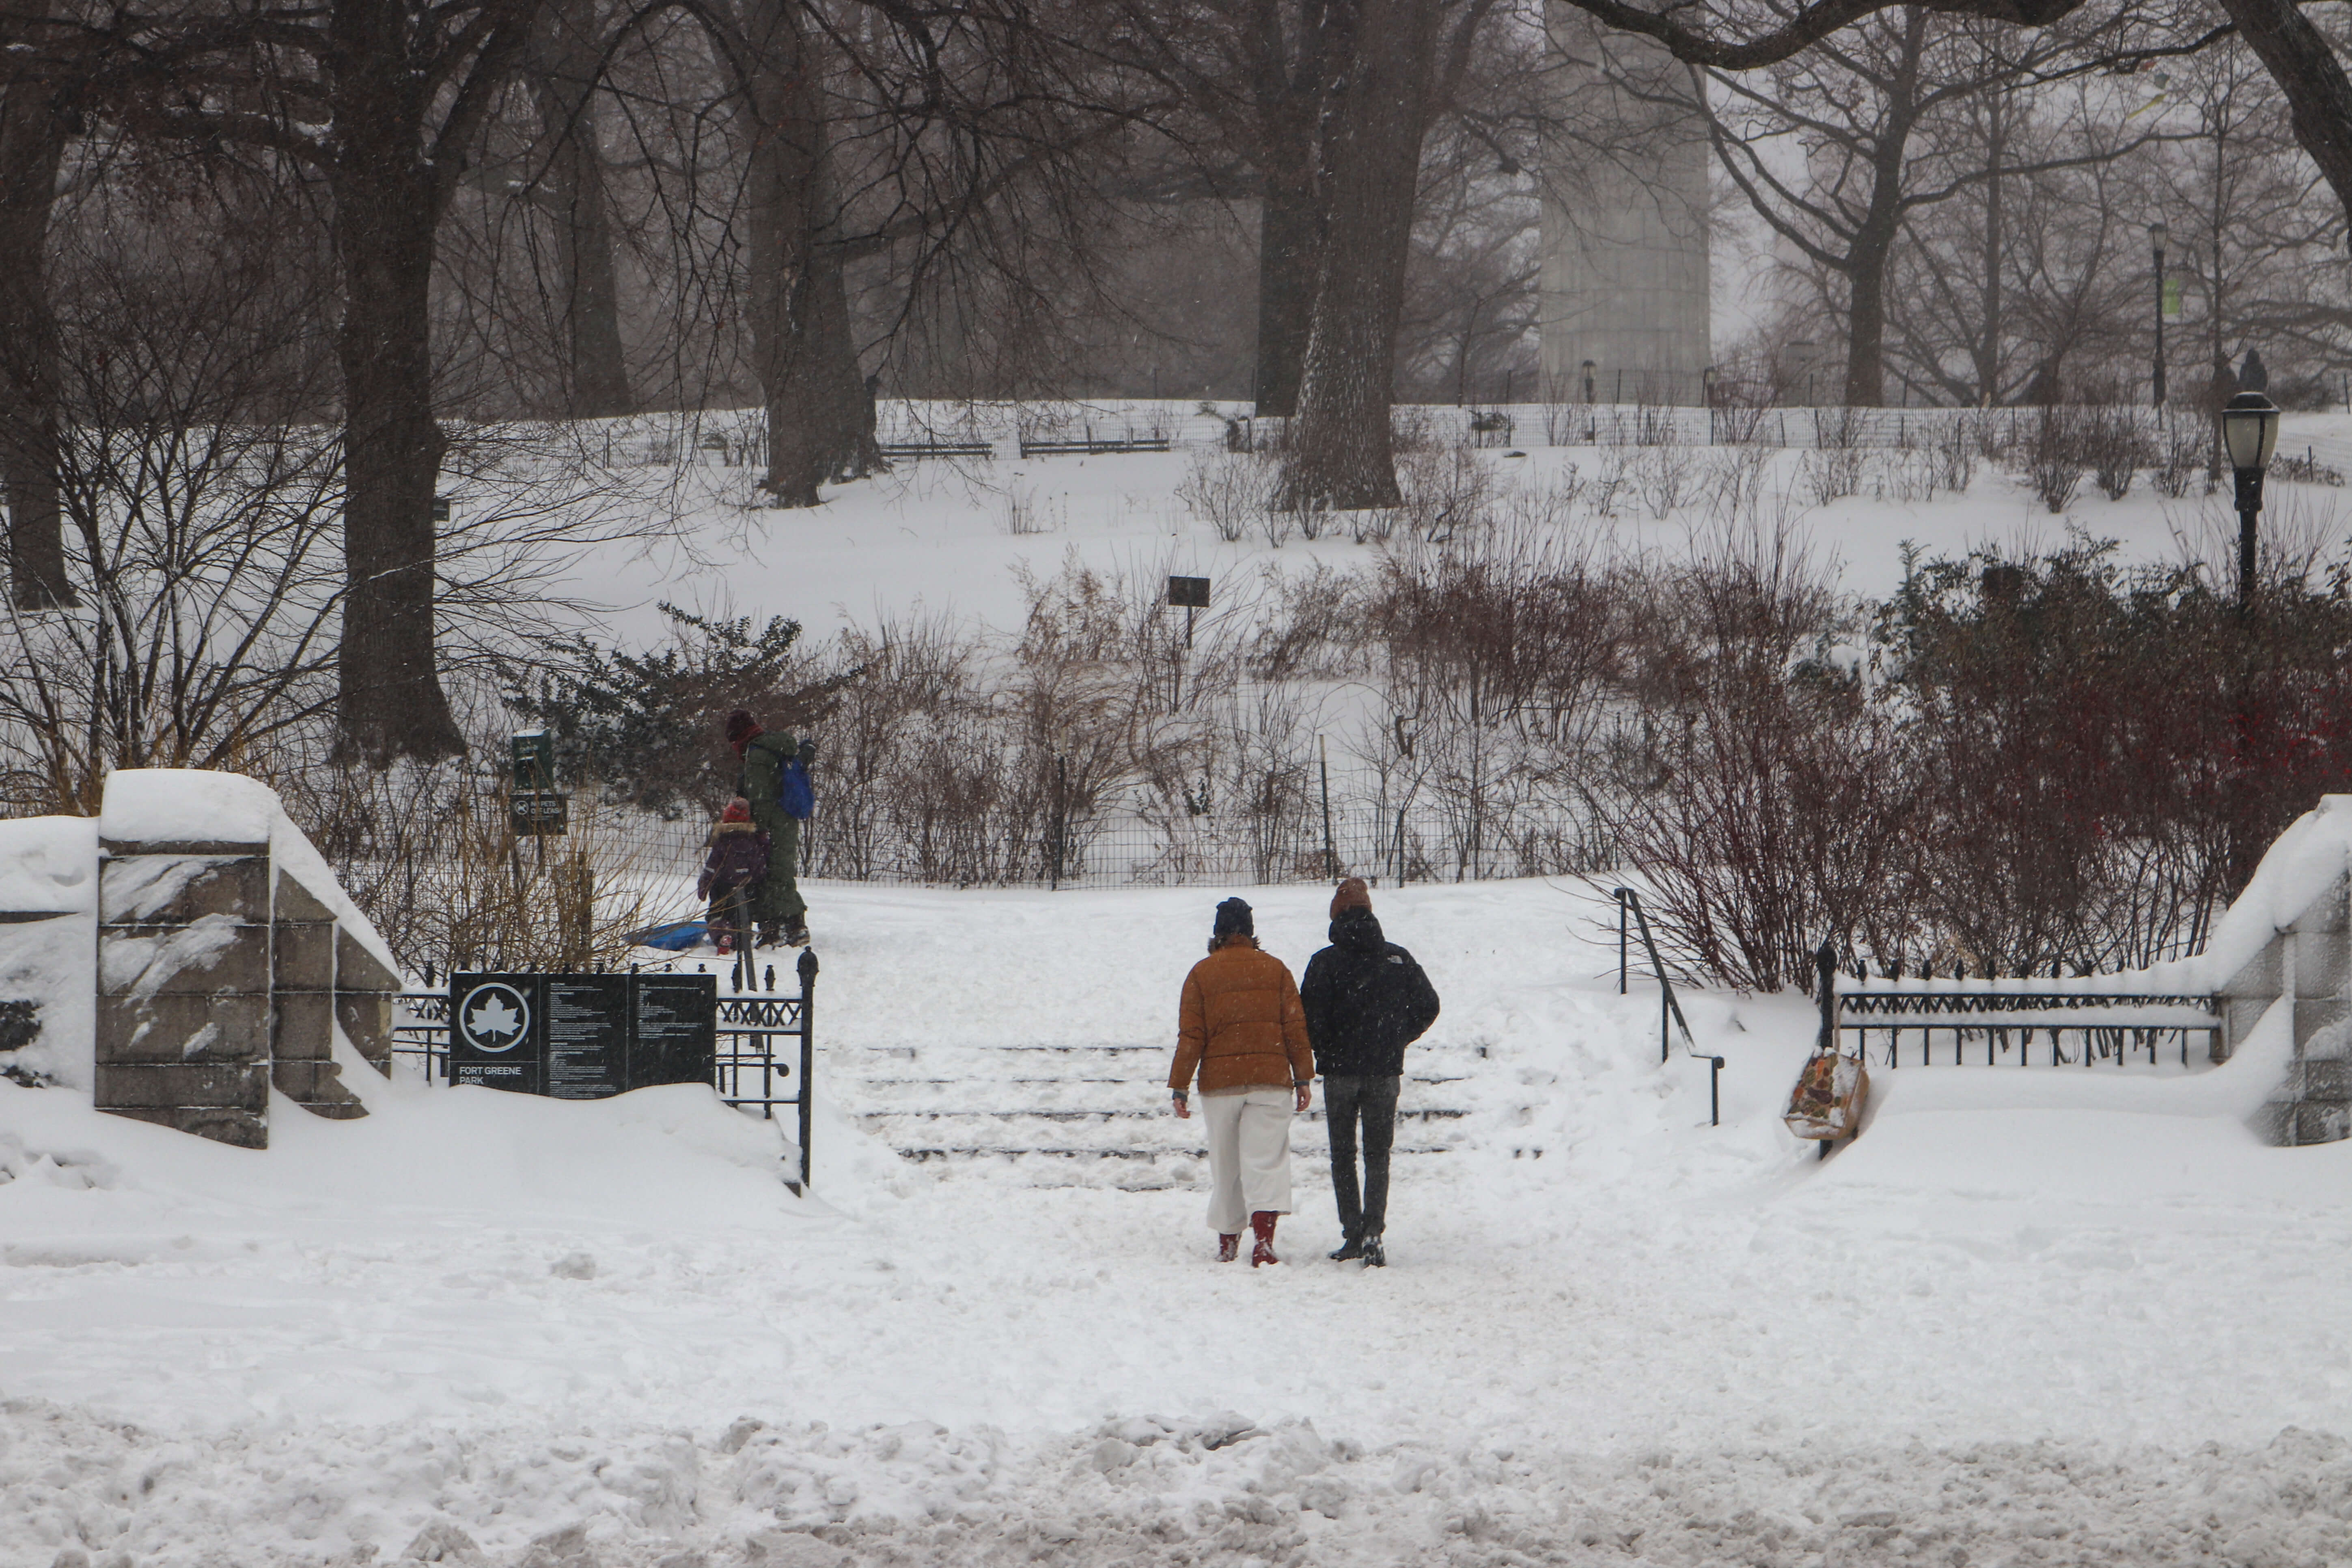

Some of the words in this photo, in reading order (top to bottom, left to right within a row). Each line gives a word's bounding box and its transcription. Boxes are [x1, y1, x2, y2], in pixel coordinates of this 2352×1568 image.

[459, 1066, 483, 1075] FORT
[484, 1066, 522, 1075] GREENE
[459, 1076, 484, 1085] PARK
